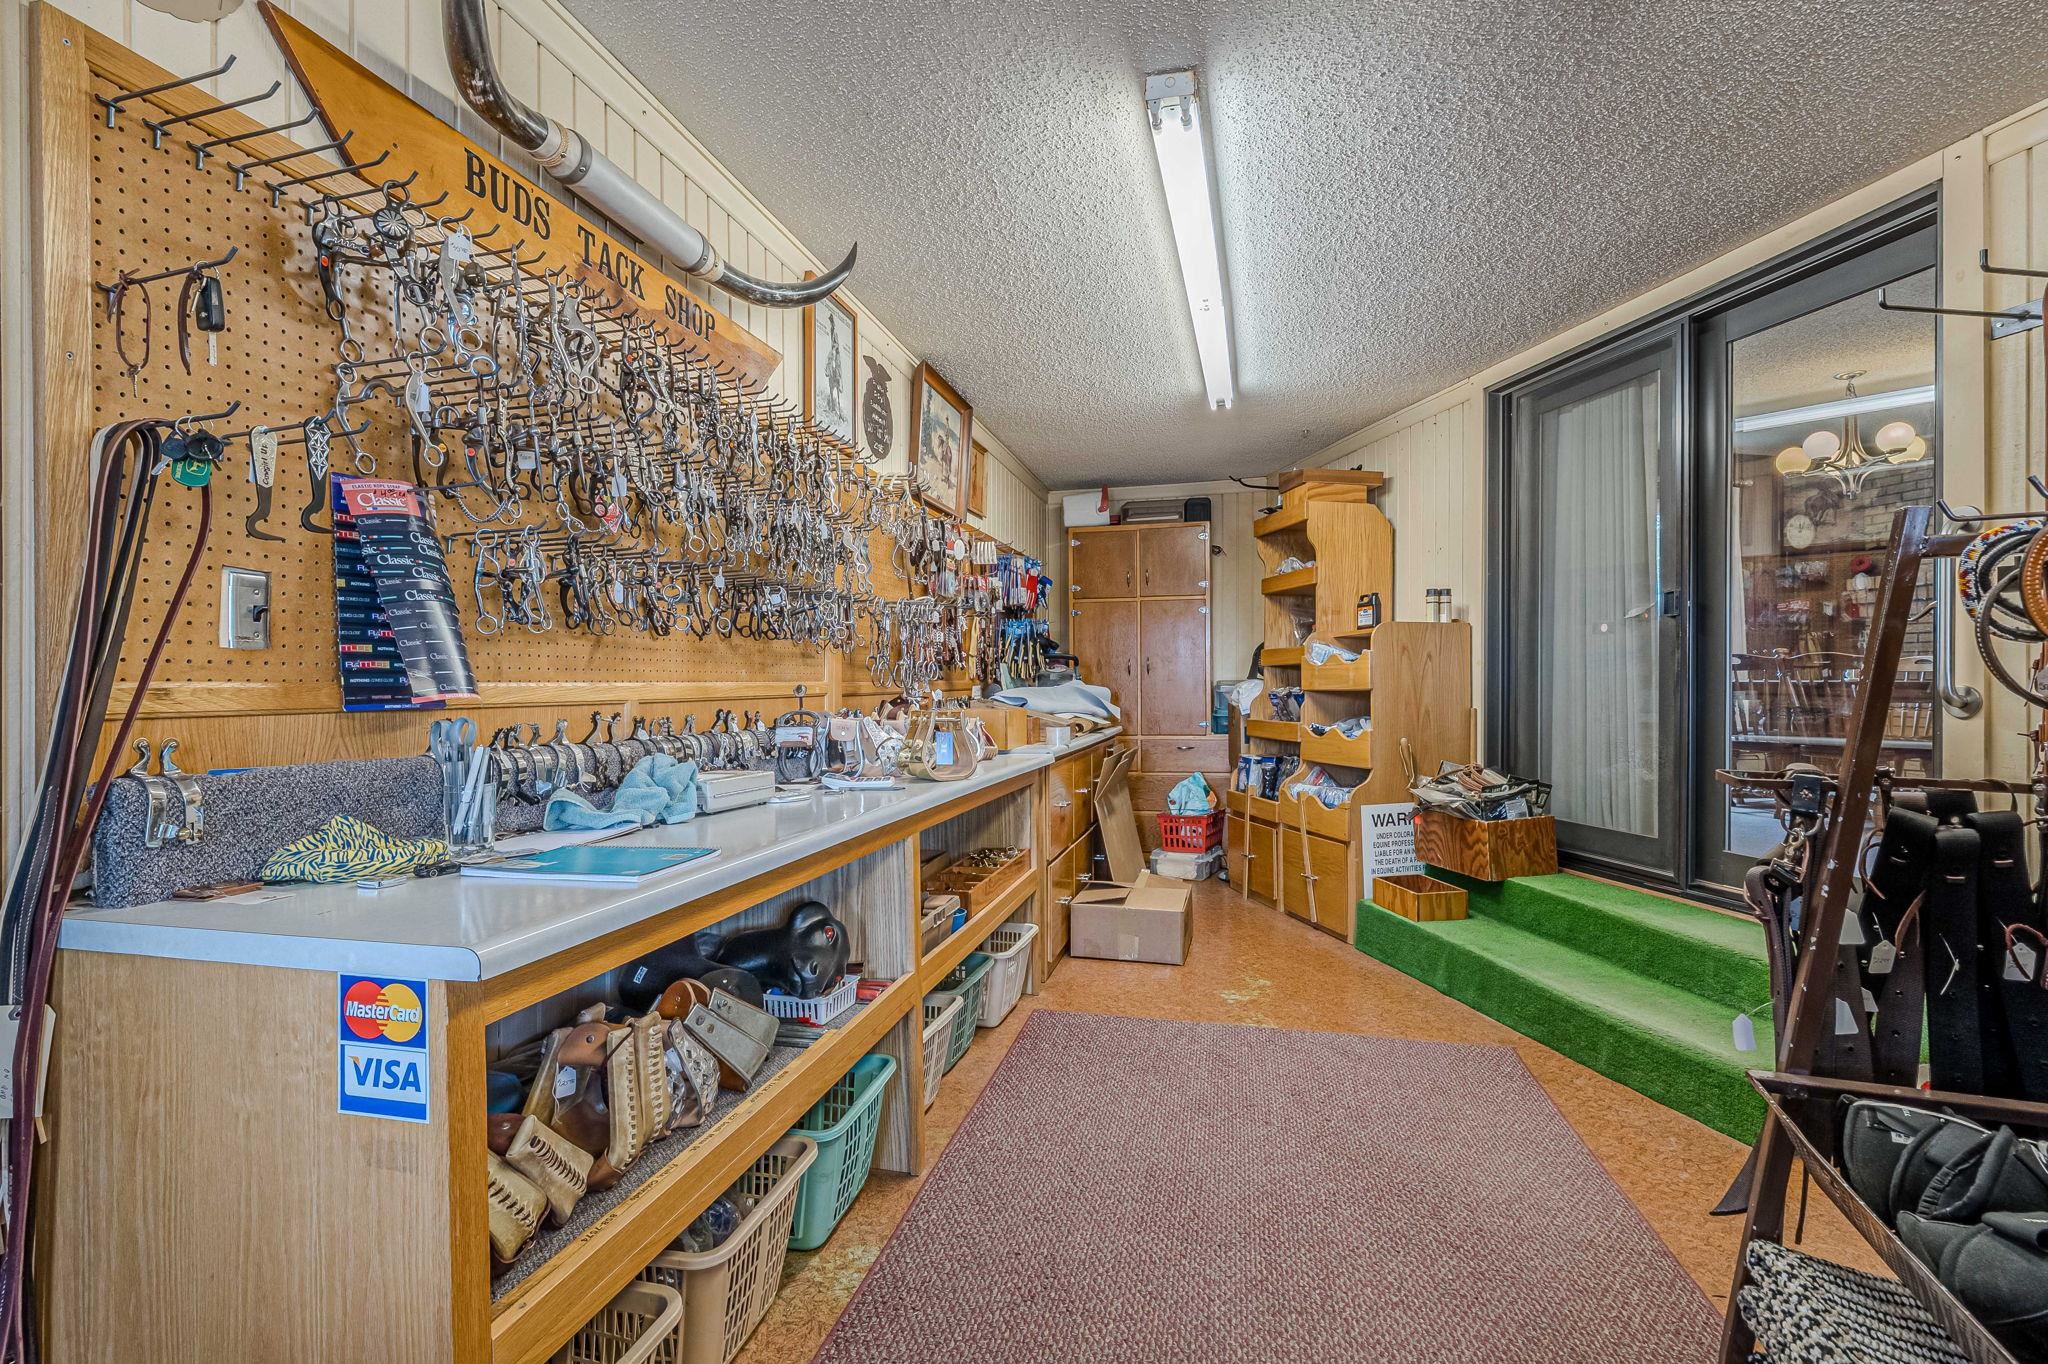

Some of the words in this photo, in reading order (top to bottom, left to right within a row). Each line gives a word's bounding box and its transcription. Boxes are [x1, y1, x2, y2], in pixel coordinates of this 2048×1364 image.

[464, 146, 551, 241] BUD'S
[577, 224, 646, 301] TACK
[664, 284, 716, 343] SHOP
[262, 458, 272, 485] Cowgirl
[357, 492, 407, 507] Classic
[358, 517, 382, 525] Classic
[378, 578, 402, 586] Classic
[405, 589, 439, 601] Classic
[388, 608, 413, 617] Classic
[399, 638, 423, 647] Classic
[345, 660, 390, 669] RATTLER
[1376, 832, 1393, 840] UNDER
[1385, 857, 1402, 865] DEATH
[1377, 867, 1395, 875] EQUINE
[1395, 865, 1422, 873] ACTIVITIES
[346, 1001, 419, 1023] MasterCard
[348, 1055, 422, 1092] VISA
[629, 1178, 660, 1202] Colorado
[580, 1212, 619, 1243] 858-7574
